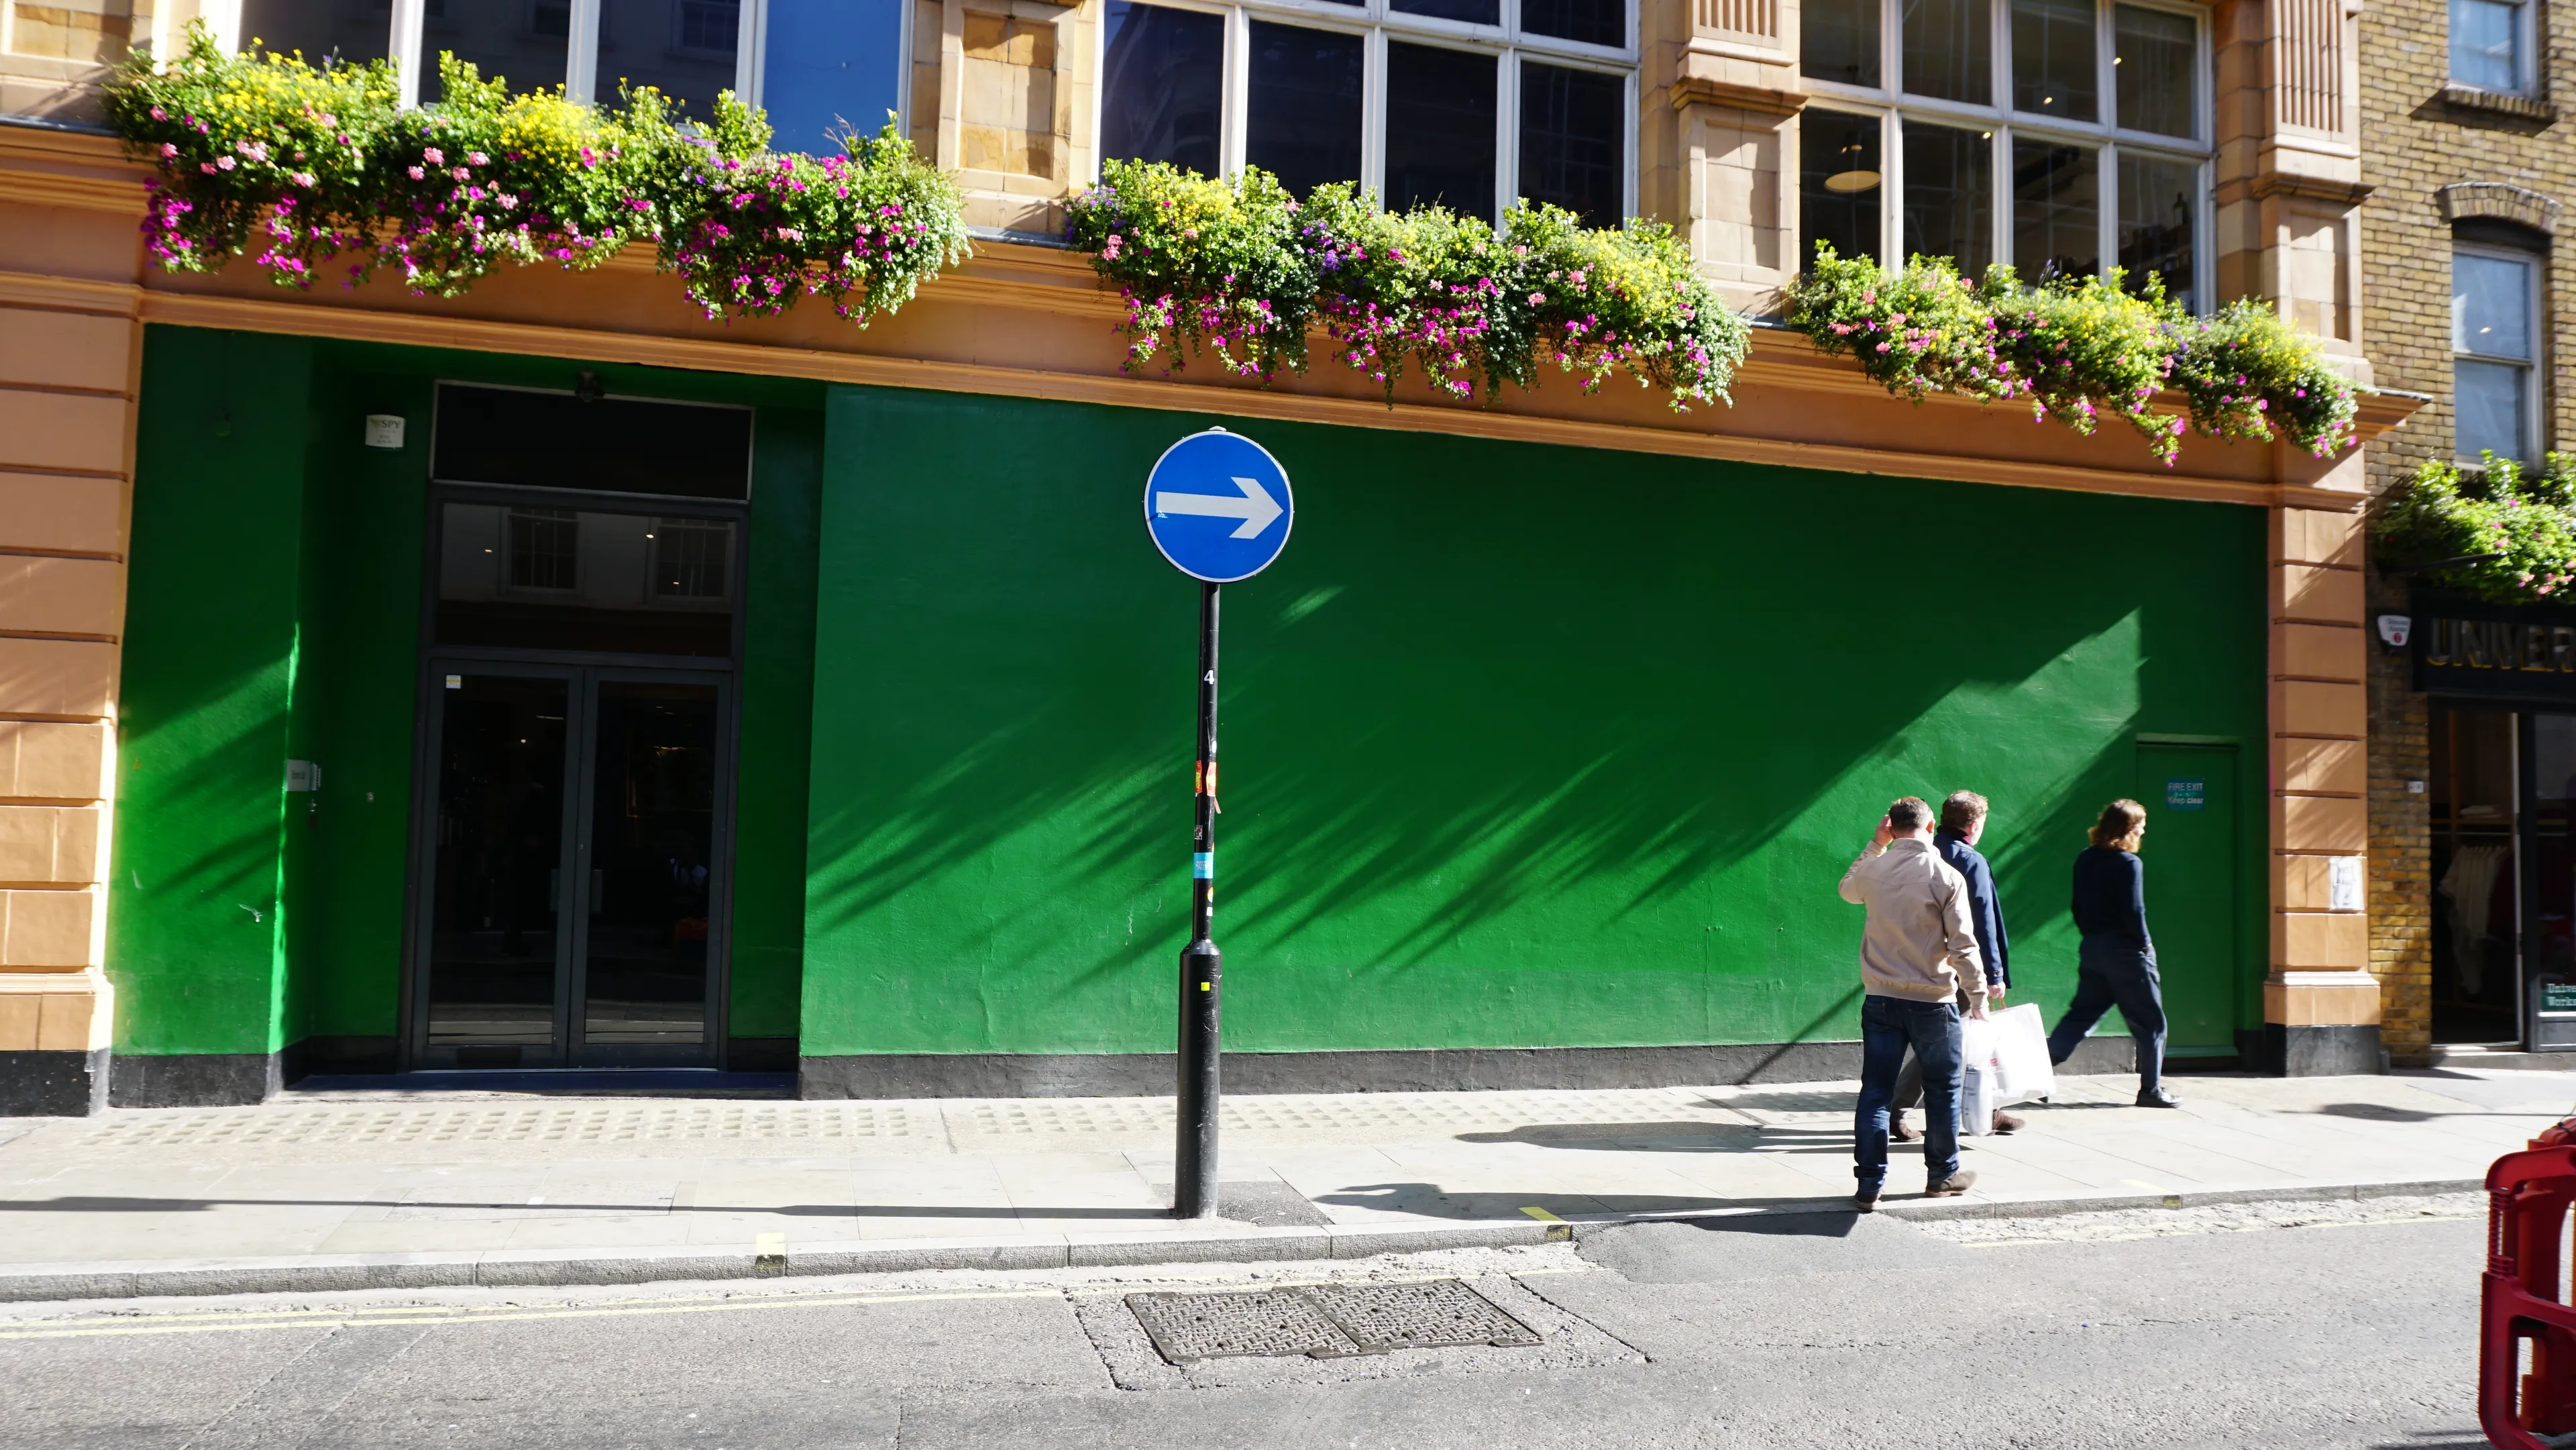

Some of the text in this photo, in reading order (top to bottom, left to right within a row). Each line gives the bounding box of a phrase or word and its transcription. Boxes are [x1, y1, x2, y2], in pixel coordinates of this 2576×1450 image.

[382, 419, 400, 429] SPY
[1203, 670, 1215, 685] 4
[2167, 782, 2204, 791] FIRE EXIT
[2168, 796, 2204, 805] Keep clear
